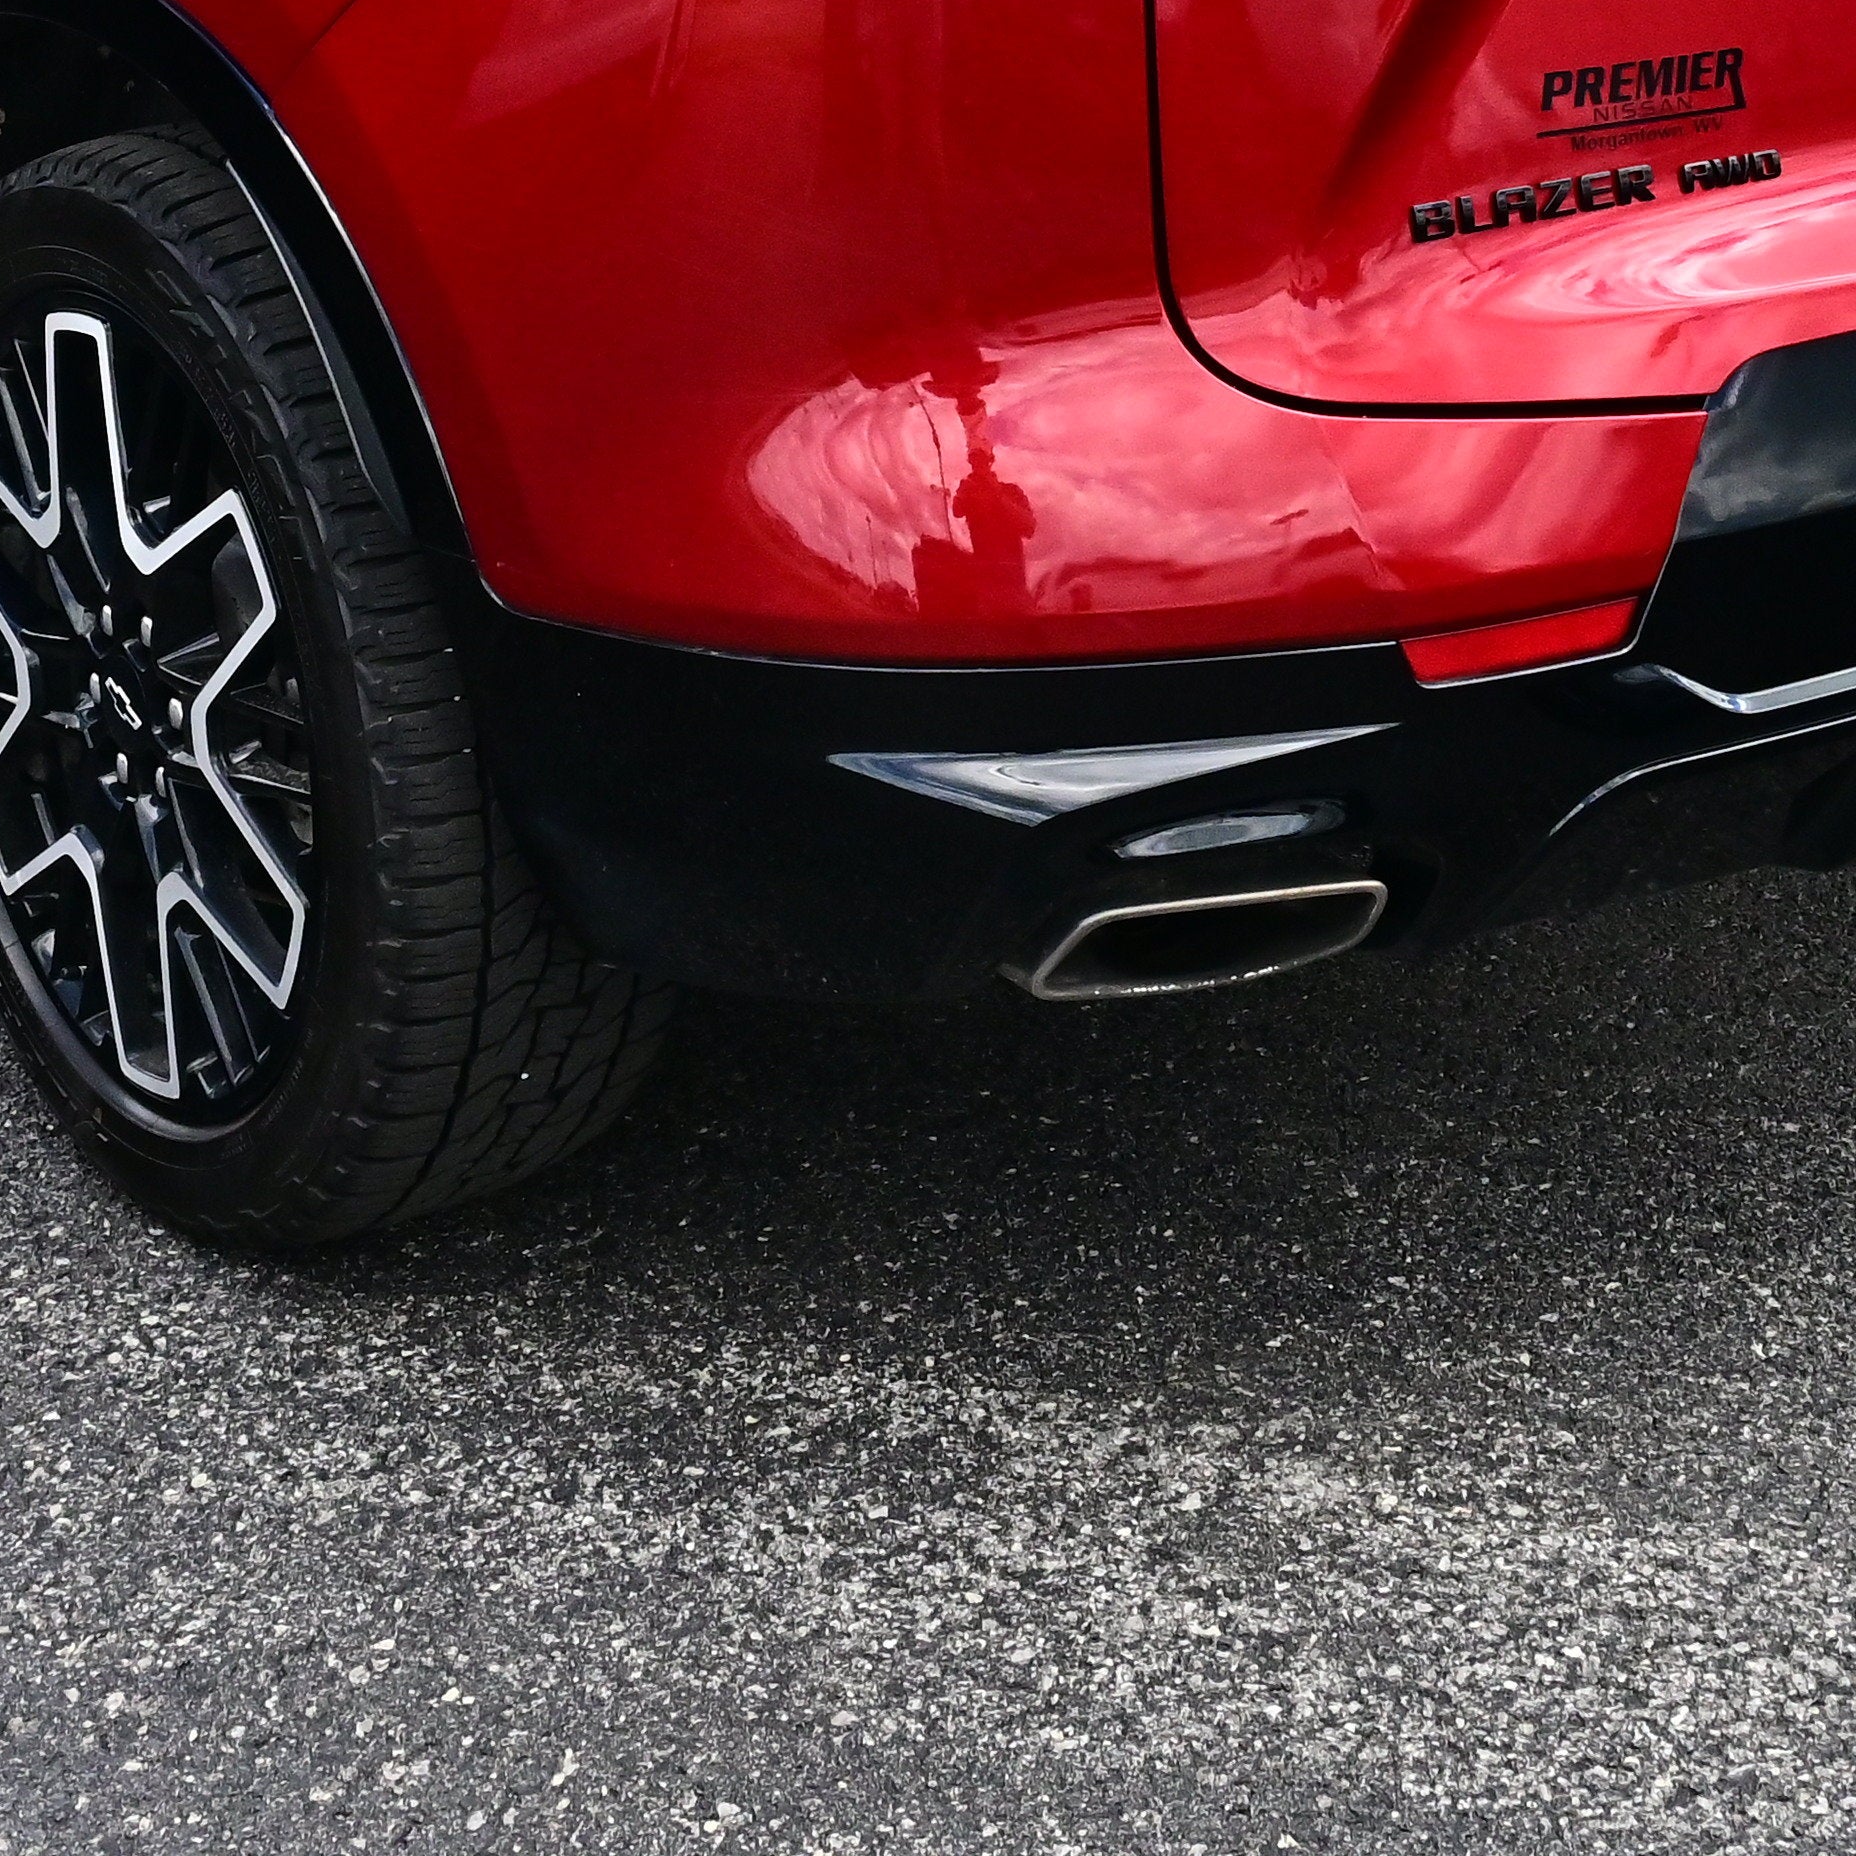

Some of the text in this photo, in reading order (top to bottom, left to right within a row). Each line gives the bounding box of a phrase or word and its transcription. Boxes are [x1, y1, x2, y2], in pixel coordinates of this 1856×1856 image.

[1540, 47, 1746, 111] PREMIER
[1594, 95, 1693, 122] NISSAN
[1408, 149, 1782, 243] BLAZER AWD
